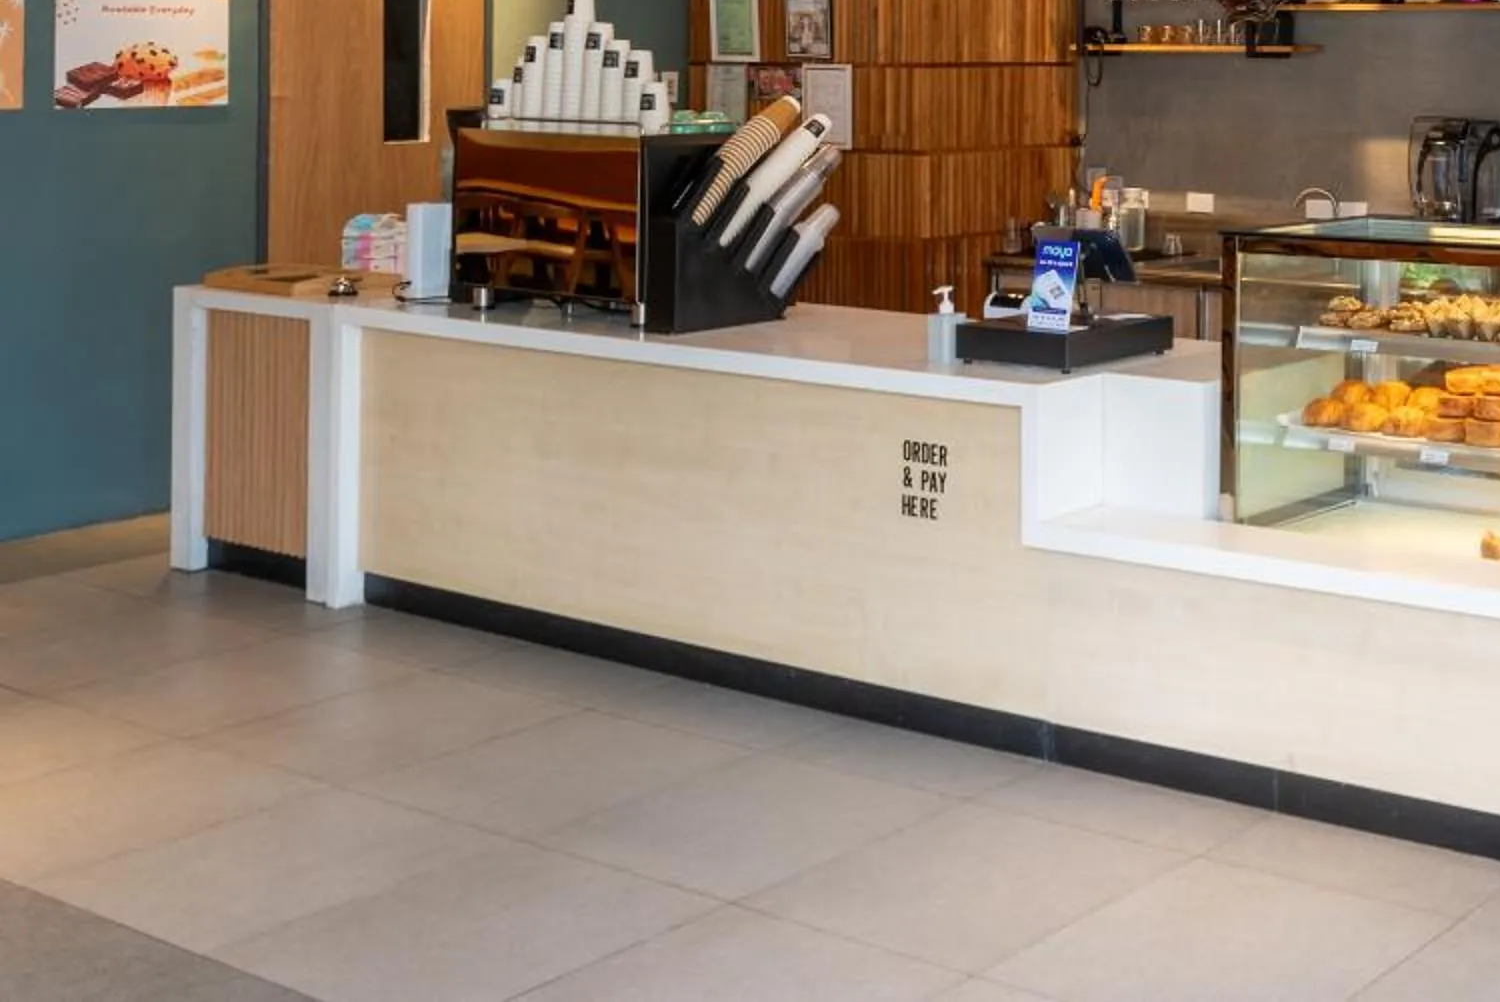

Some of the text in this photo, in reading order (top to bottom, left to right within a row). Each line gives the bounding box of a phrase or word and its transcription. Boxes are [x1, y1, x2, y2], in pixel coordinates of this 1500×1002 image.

[903, 439, 948, 467] ORDER
[903, 465, 947, 494] & PAY
[901, 493, 938, 520] HERE
